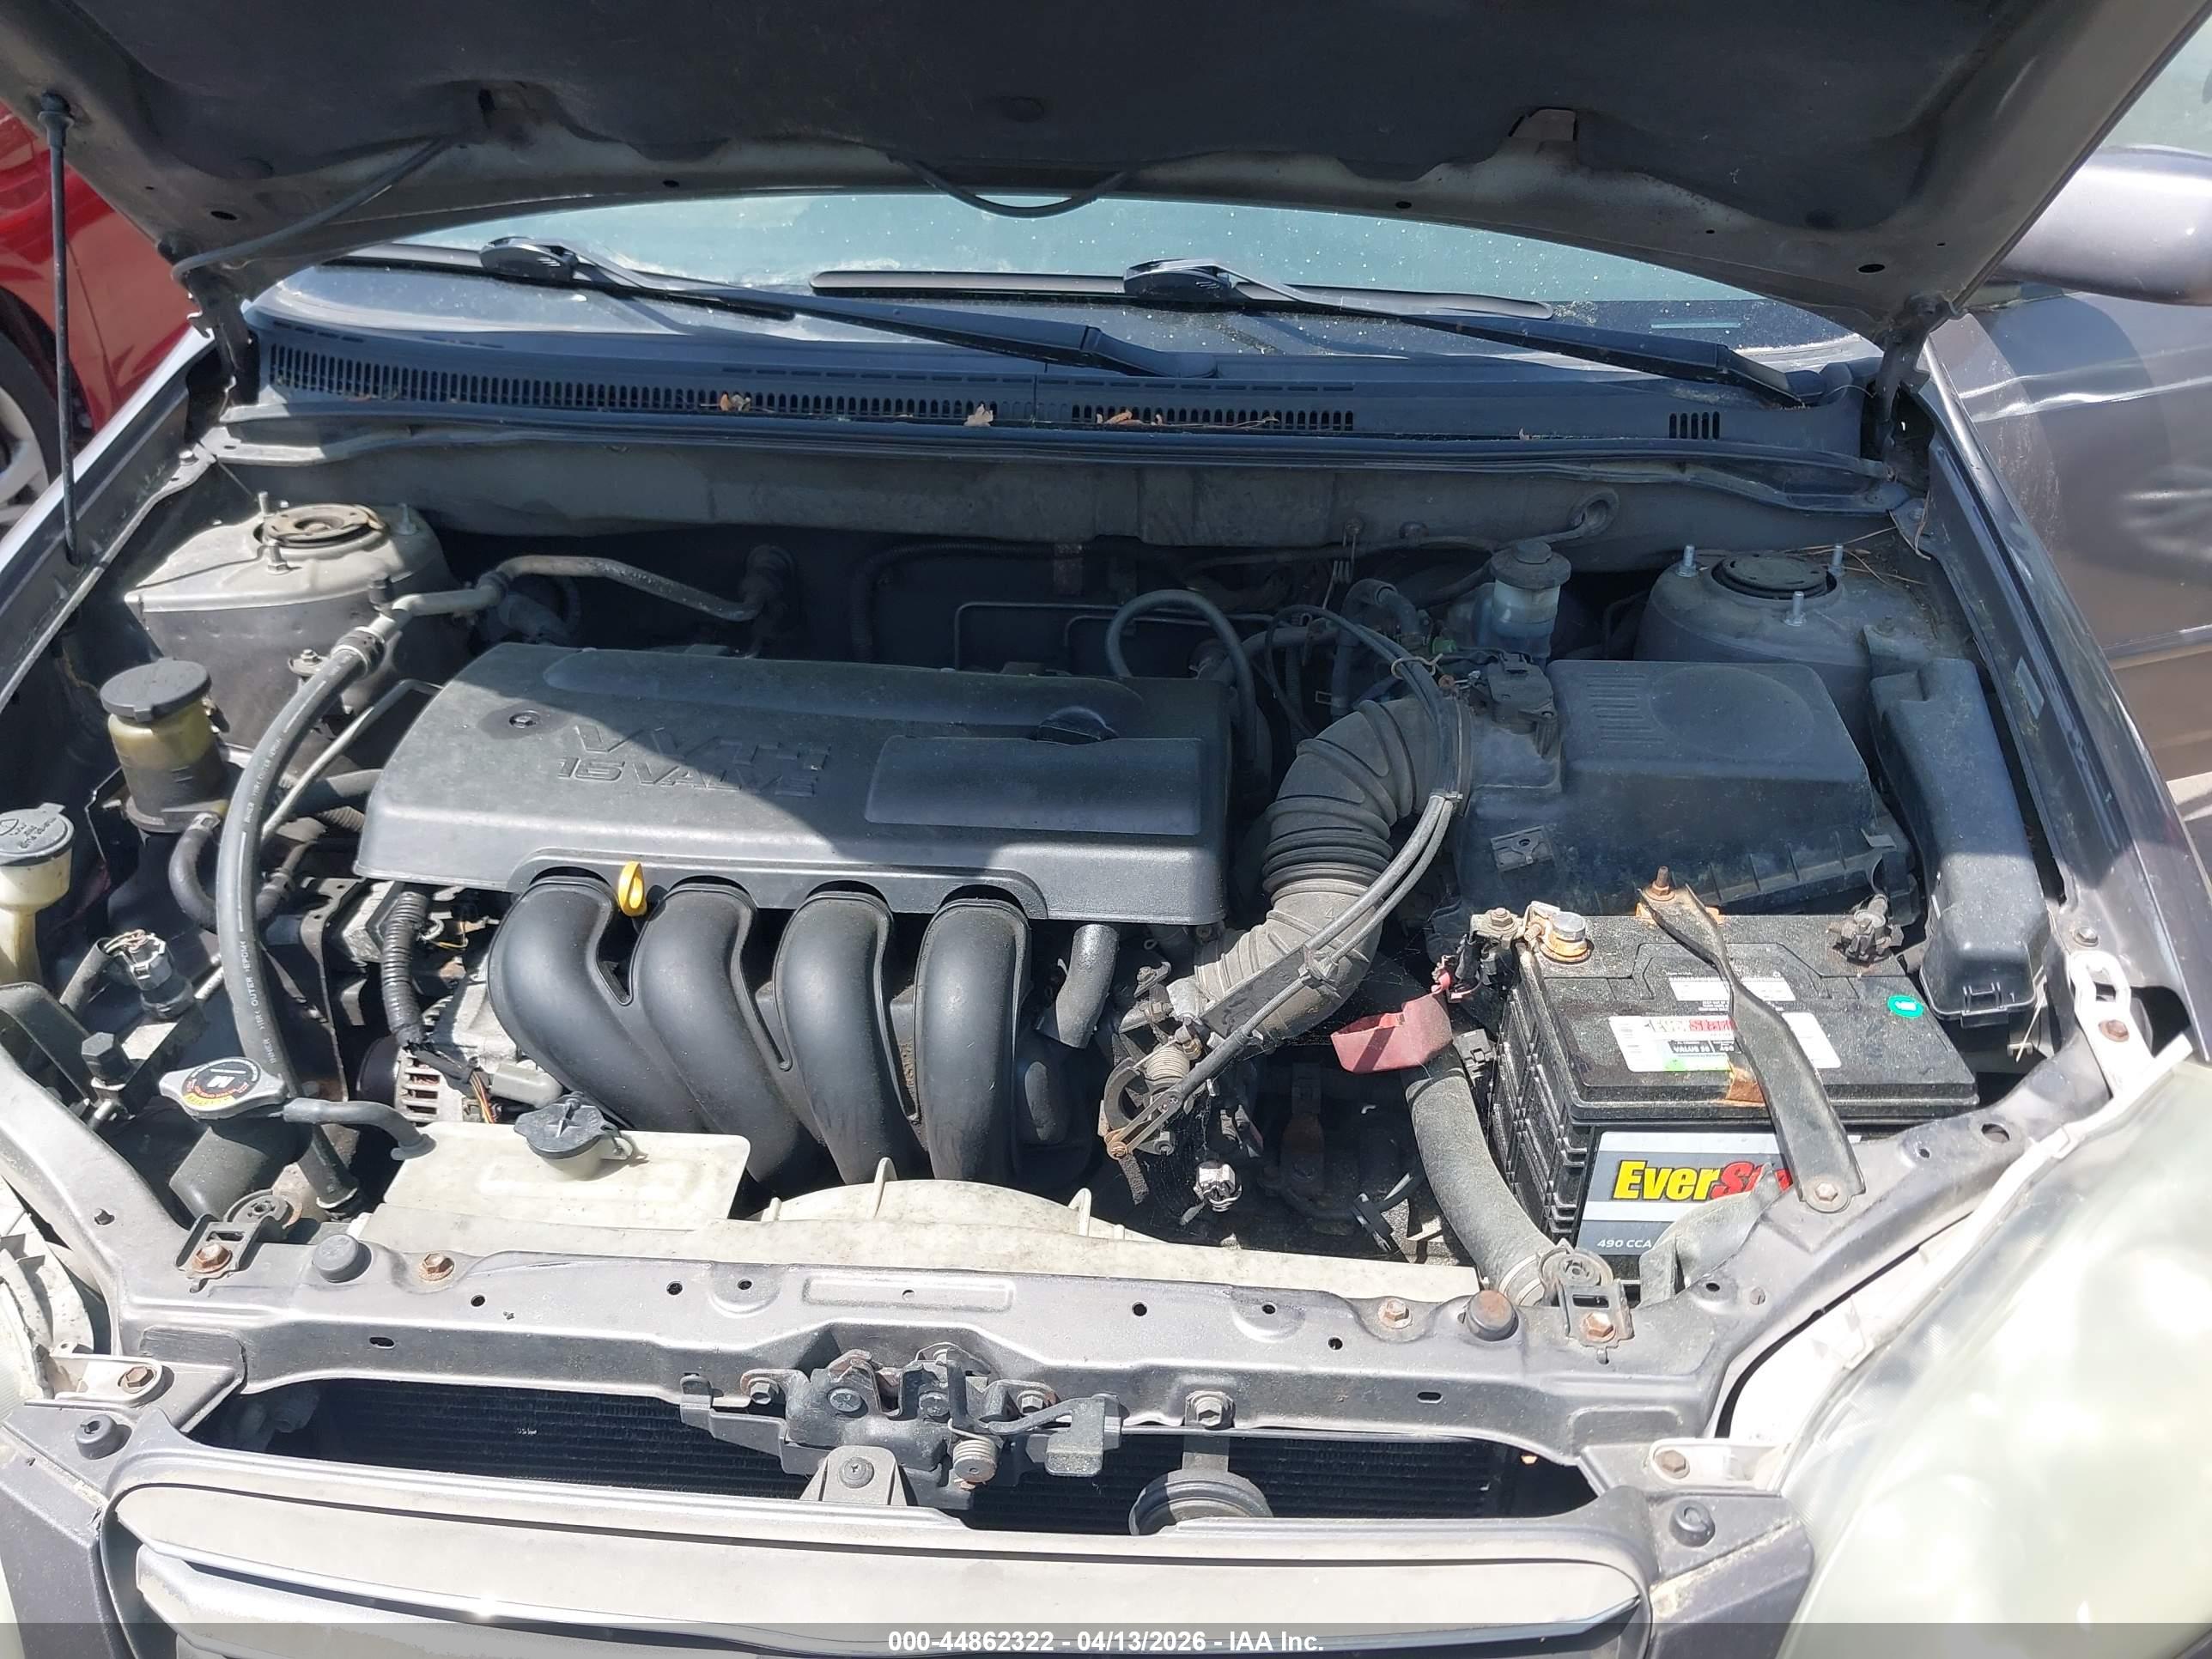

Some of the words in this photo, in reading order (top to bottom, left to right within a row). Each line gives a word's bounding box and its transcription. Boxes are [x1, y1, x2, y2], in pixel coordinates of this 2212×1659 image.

[245, 976, 259, 1007] OUTER
[1597, 1239, 1624, 1249] 490
[1626, 1239, 1653, 1249] CCA
